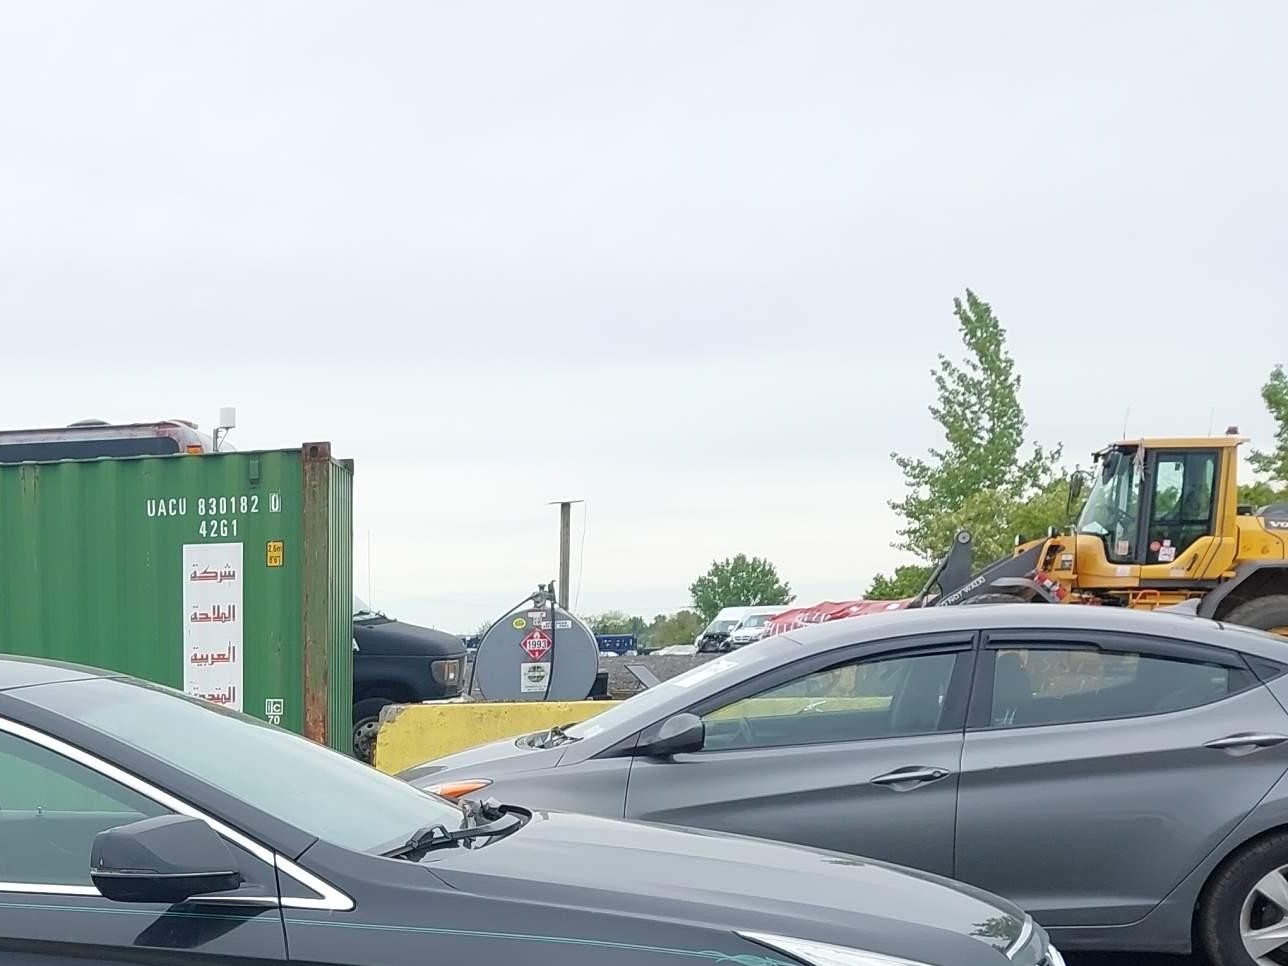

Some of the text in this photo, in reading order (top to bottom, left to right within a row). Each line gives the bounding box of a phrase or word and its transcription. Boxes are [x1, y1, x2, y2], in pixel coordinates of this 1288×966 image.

[147, 498, 187, 517] UACU
[198, 495, 259, 516] 830182
[199, 520, 237, 538] 42G1
[190, 563, 236, 584] شركة
[190, 604, 236, 623] الملاحة
[528, 640, 547, 649] 1993
[191, 645, 236, 666] العربية
[268, 715, 280, 724] 70
